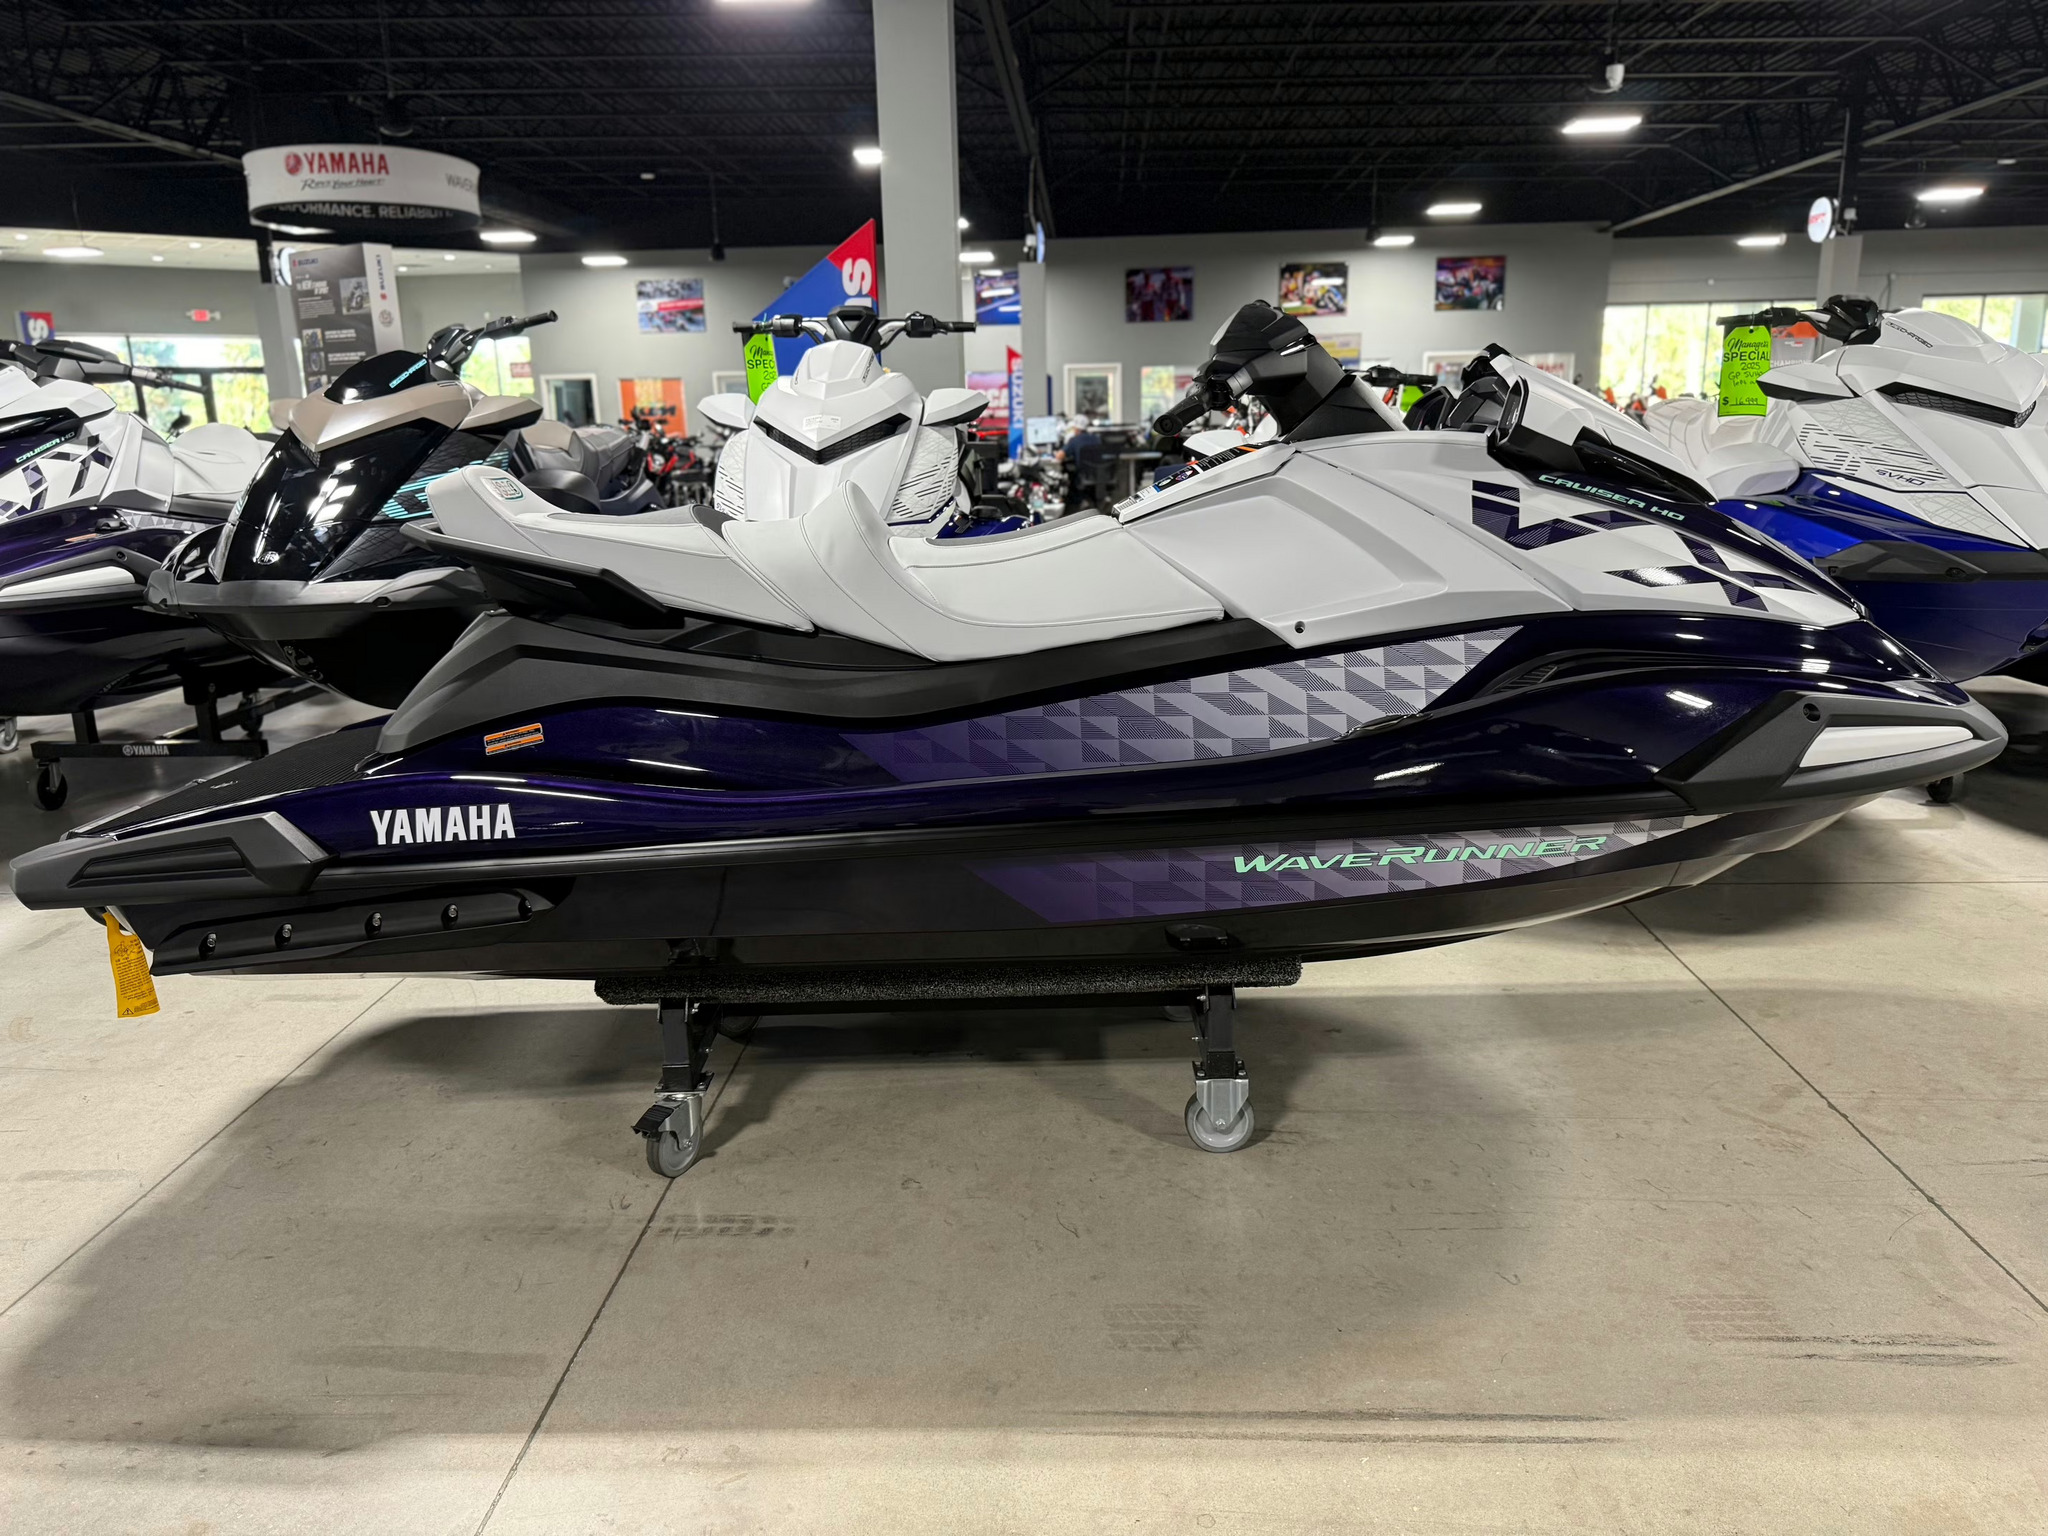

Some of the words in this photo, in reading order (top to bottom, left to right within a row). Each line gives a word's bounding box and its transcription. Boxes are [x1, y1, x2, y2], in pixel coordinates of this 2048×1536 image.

[304, 152, 390, 175] YAMAHA
[1723, 350, 1770, 362] SPECIAL
[1010, 358, 1024, 429] SUZUKI
[1721, 396, 1729, 406] $
[15, 438, 60, 464] CRUISER
[61, 431, 76, 442] HO
[1875, 468, 1926, 486] SVHO
[1538, 474, 1647, 509] CRUISER
[1650, 506, 1686, 521] HO
[132, 744, 170, 756] YAMAHA
[369, 803, 516, 846] YAMAHA
